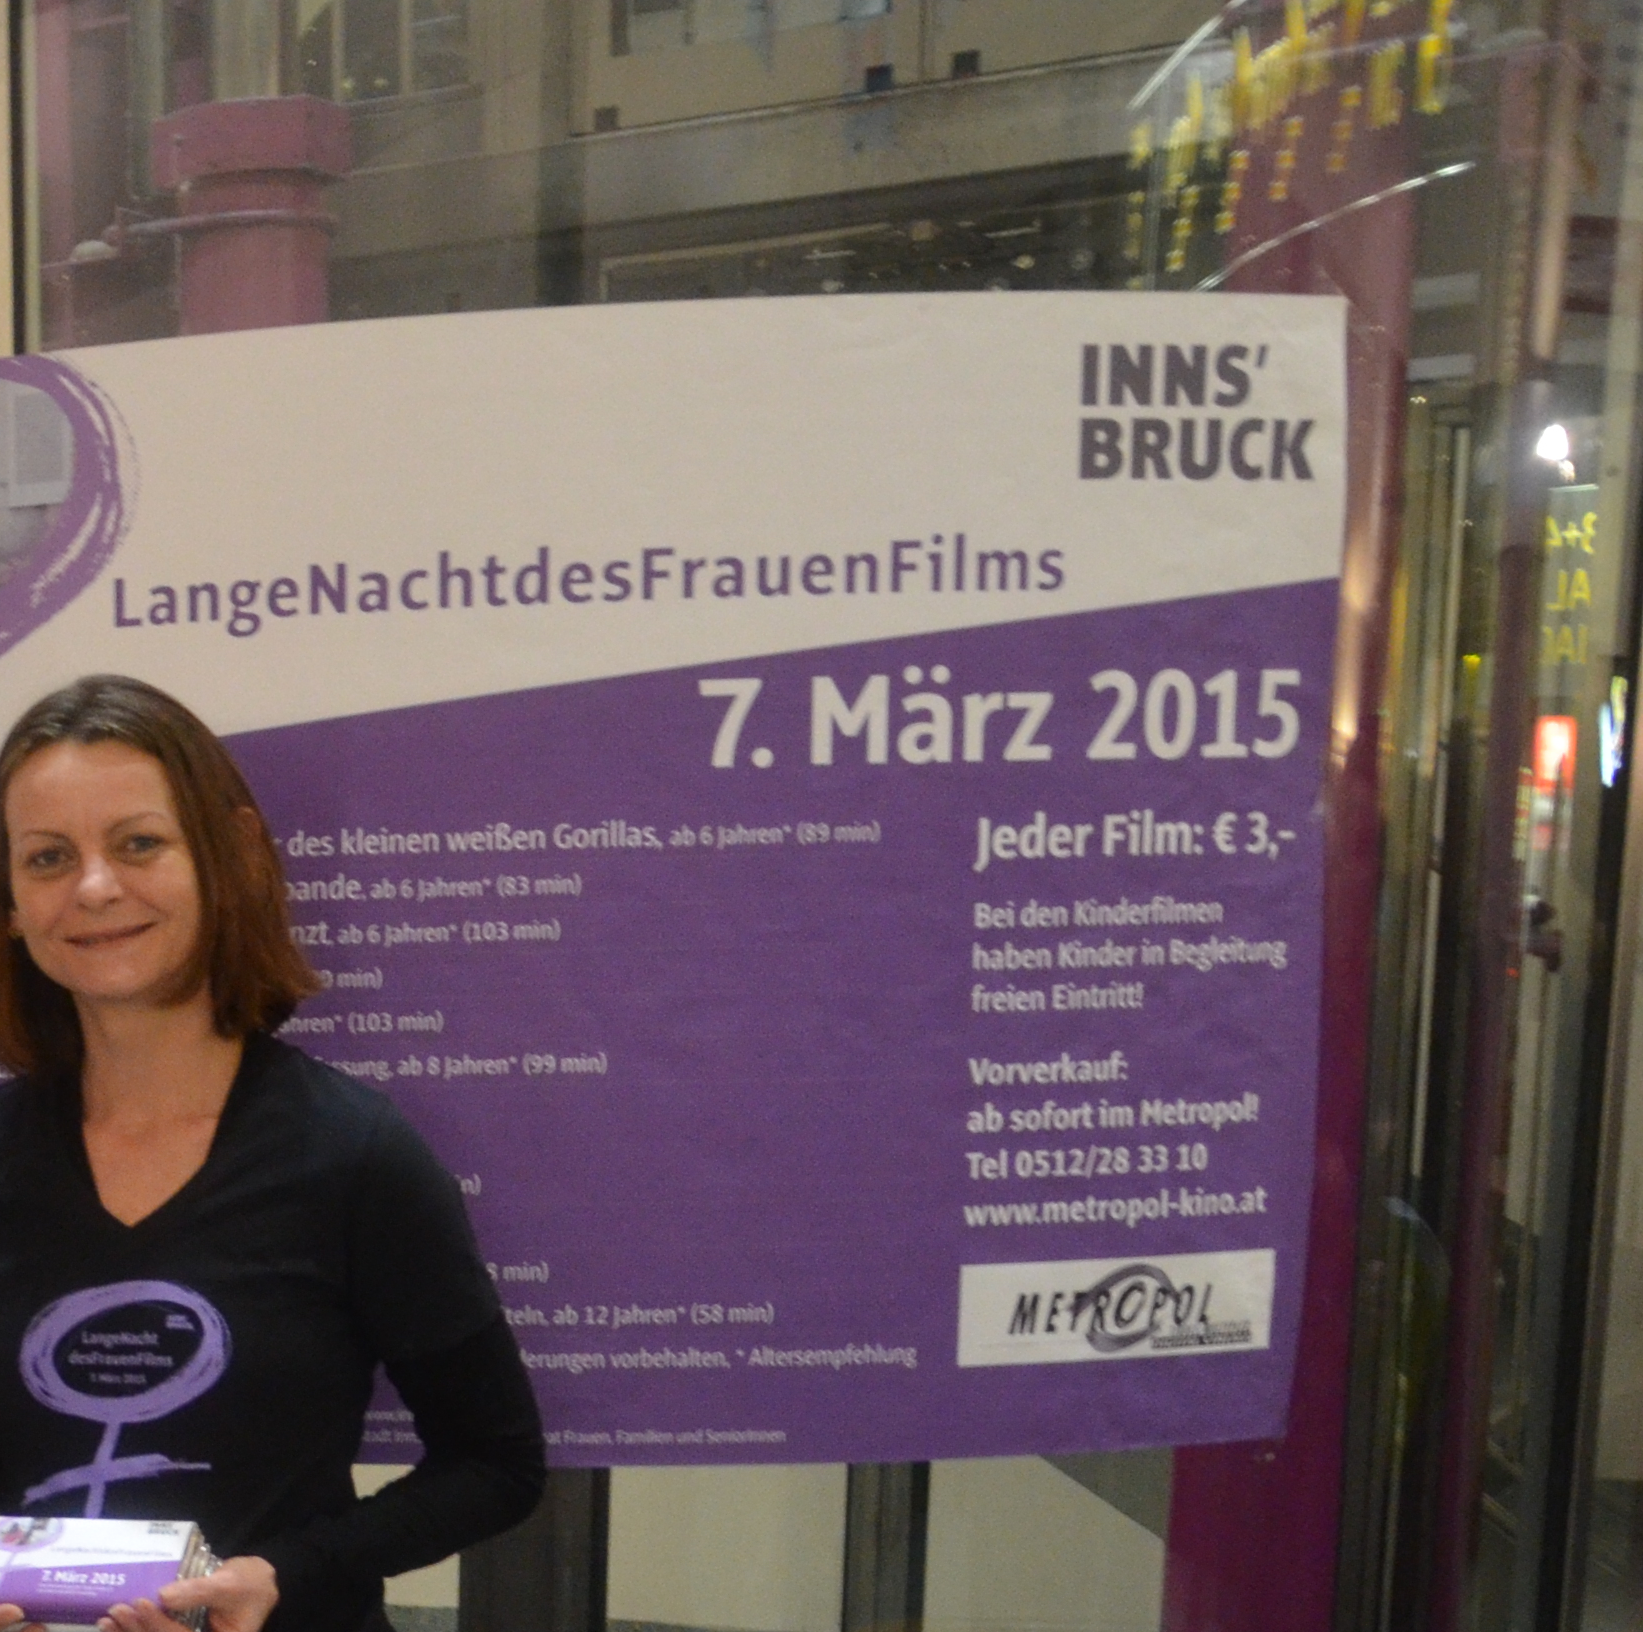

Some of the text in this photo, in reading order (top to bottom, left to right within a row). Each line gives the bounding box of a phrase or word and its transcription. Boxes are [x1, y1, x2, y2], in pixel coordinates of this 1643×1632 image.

[1080, 343, 1269, 407] INNS'
[1078, 417, 1315, 481] BRUCK
[114, 533, 1066, 638] LangeNachtdesFrauenFilms
[696, 665, 1301, 769] 7. März 2015
[287, 829, 334, 857] des
[341, 828, 440, 856] kleinen
[446, 822, 547, 854] weißen
[553, 820, 663, 851] Gorillas,
[670, 825, 696, 847] ab
[699, 825, 713, 846] 6
[834, 820, 882, 846] min)
[973, 811, 1093, 873] Jeder
[1102, 809, 1205, 856] Film:
[1212, 812, 1237, 854] €
[370, 881, 396, 900] ab
[400, 880, 413, 900] 6
[532, 874, 582, 898] min)
[973, 896, 1223, 929] Bei den Kinderfilmen
[336, 923, 363, 945] ab
[367, 923, 381, 944] 6
[462, 921, 509, 946] (103
[512, 919, 562, 944] min)
[972, 936, 1288, 972] haben Kinder in Begleitung
[337, 967, 384, 990] min)
[971, 981, 1144, 1012] freien Eintritt!
[347, 1012, 393, 1036] (103
[397, 1009, 445, 1034] min)
[397, 1055, 423, 1076] ab
[427, 1055, 441, 1076] 8
[560, 1051, 608, 1075] min)
[968, 1050, 1129, 1085] Vorverkauf:
[966, 1091, 1261, 1134] ab sofort im Metropol!
[965, 1143, 1208, 1180] Tel 0512/28 33 10
[964, 1186, 1267, 1228] www.metropol-kino.at
[502, 1260, 550, 1284] min)
[553, 1304, 579, 1325] ab
[583, 1305, 609, 1326] 12
[728, 1302, 774, 1326] min)
[1008, 1283, 1212, 1337] METROPOL
[676, 1429, 703, 1444] und
